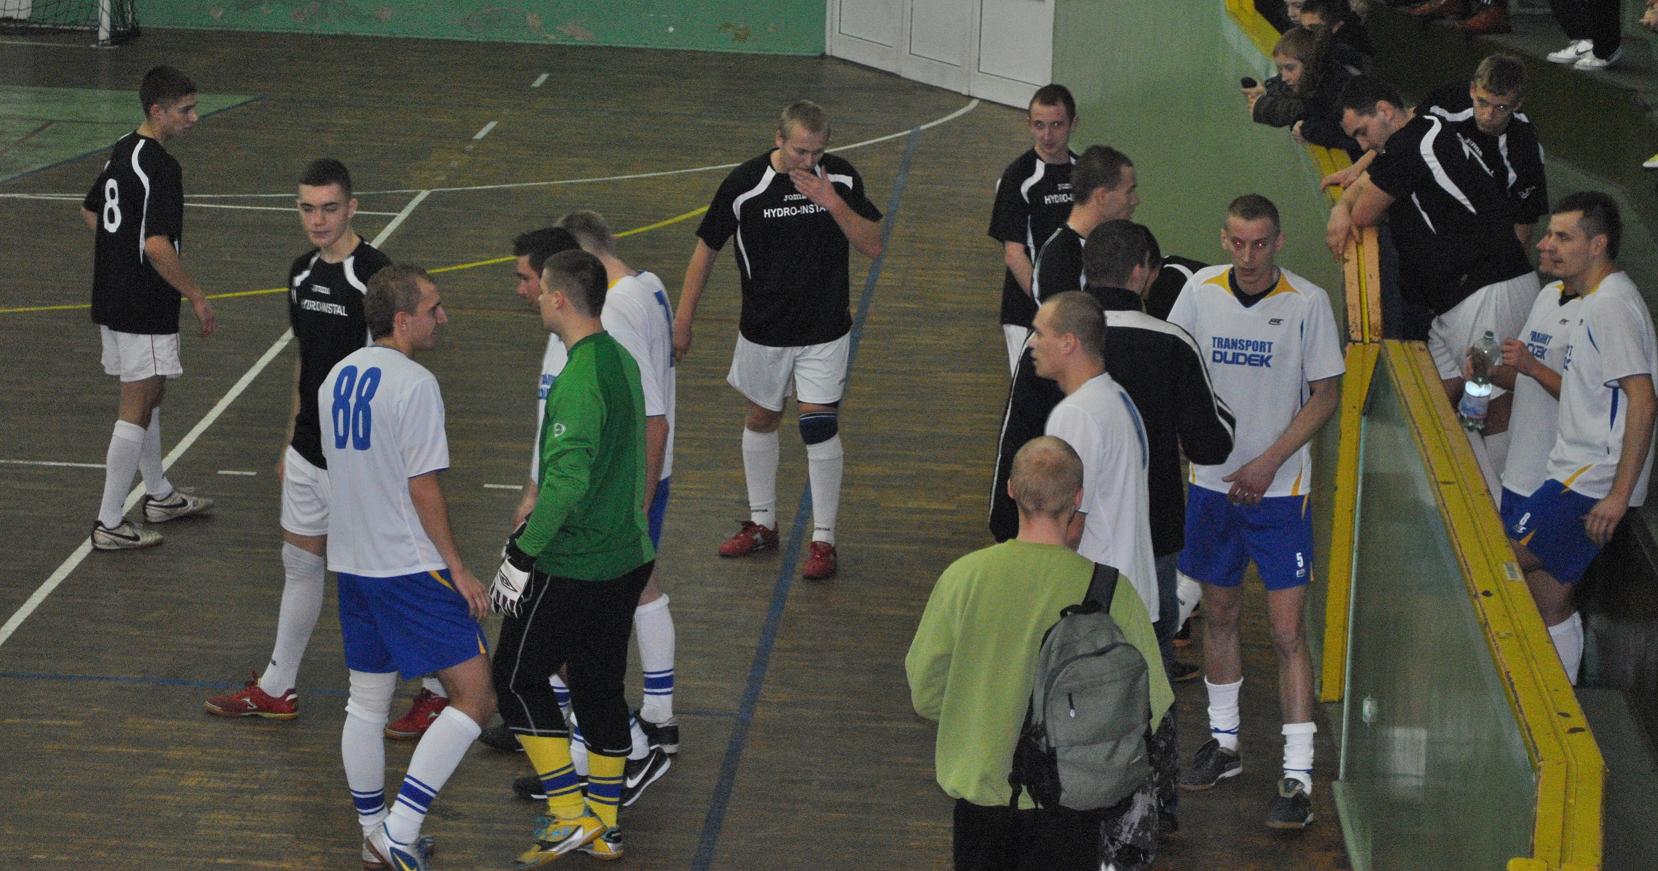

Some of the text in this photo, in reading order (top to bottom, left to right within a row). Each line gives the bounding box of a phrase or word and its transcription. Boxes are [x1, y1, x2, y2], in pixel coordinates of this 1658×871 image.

[103, 178, 122, 233] 8
[763, 204, 827, 219] HYDRO-INSTA
[1212, 336, 1274, 353] TRANSPORT
[1212, 350, 1273, 368] DUDEK
[331, 365, 382, 451] 88
[1296, 551, 1304, 568] 5
